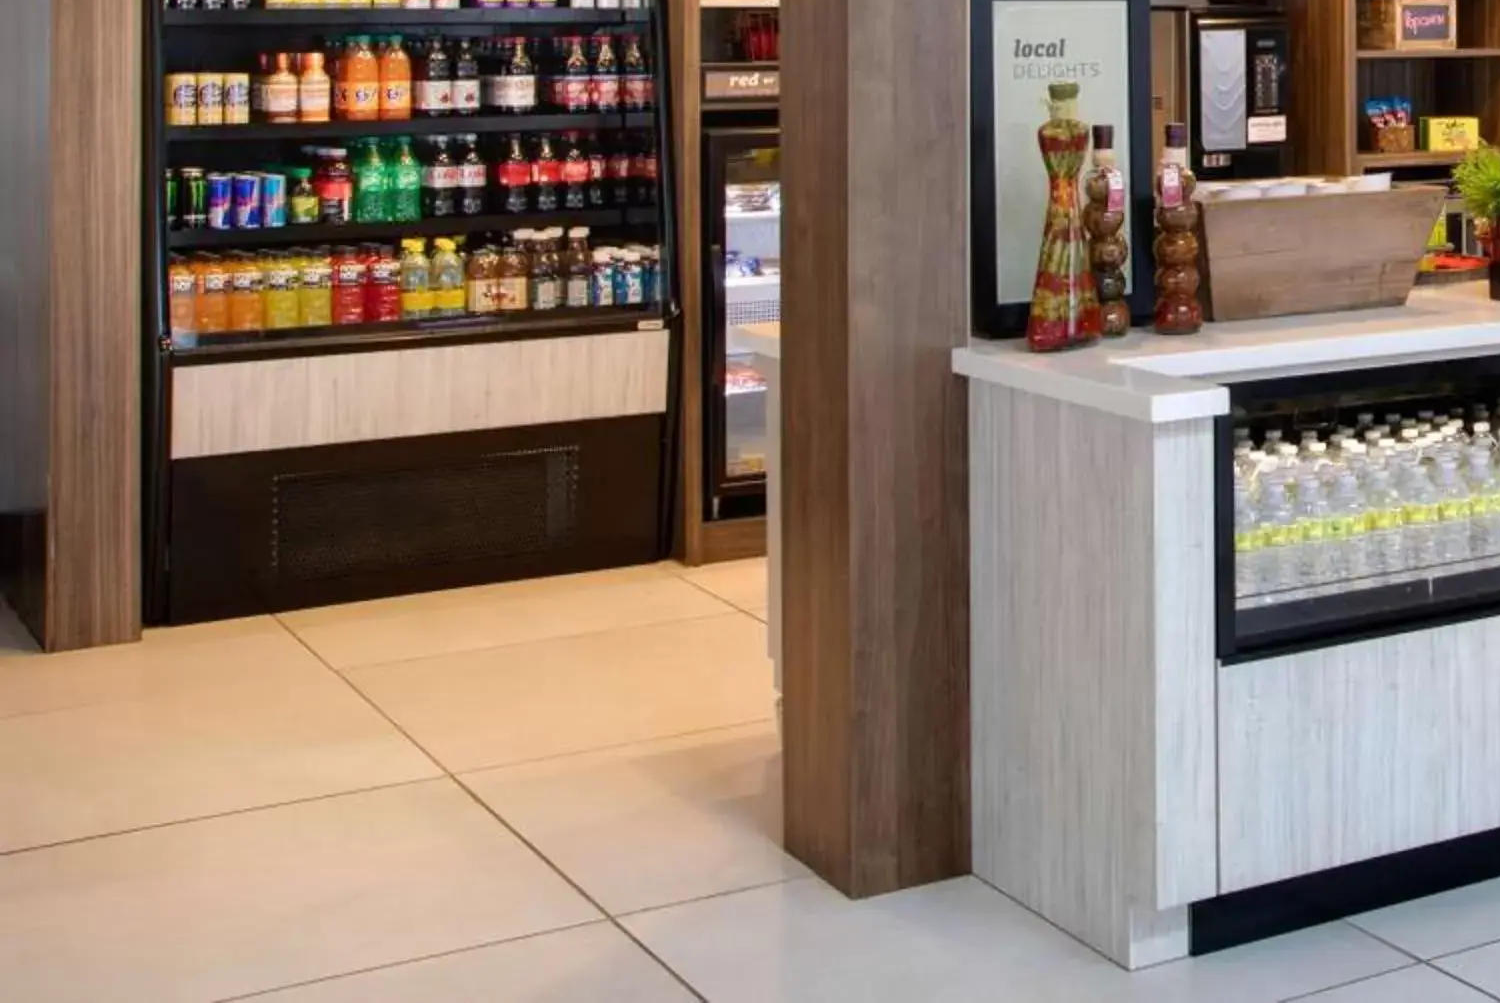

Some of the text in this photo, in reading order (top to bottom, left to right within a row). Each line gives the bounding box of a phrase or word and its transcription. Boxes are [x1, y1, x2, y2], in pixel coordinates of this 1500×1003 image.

[1013, 38, 1066, 58] local
[729, 71, 760, 87] red
[1013, 62, 1101, 80] DELIGHTS
